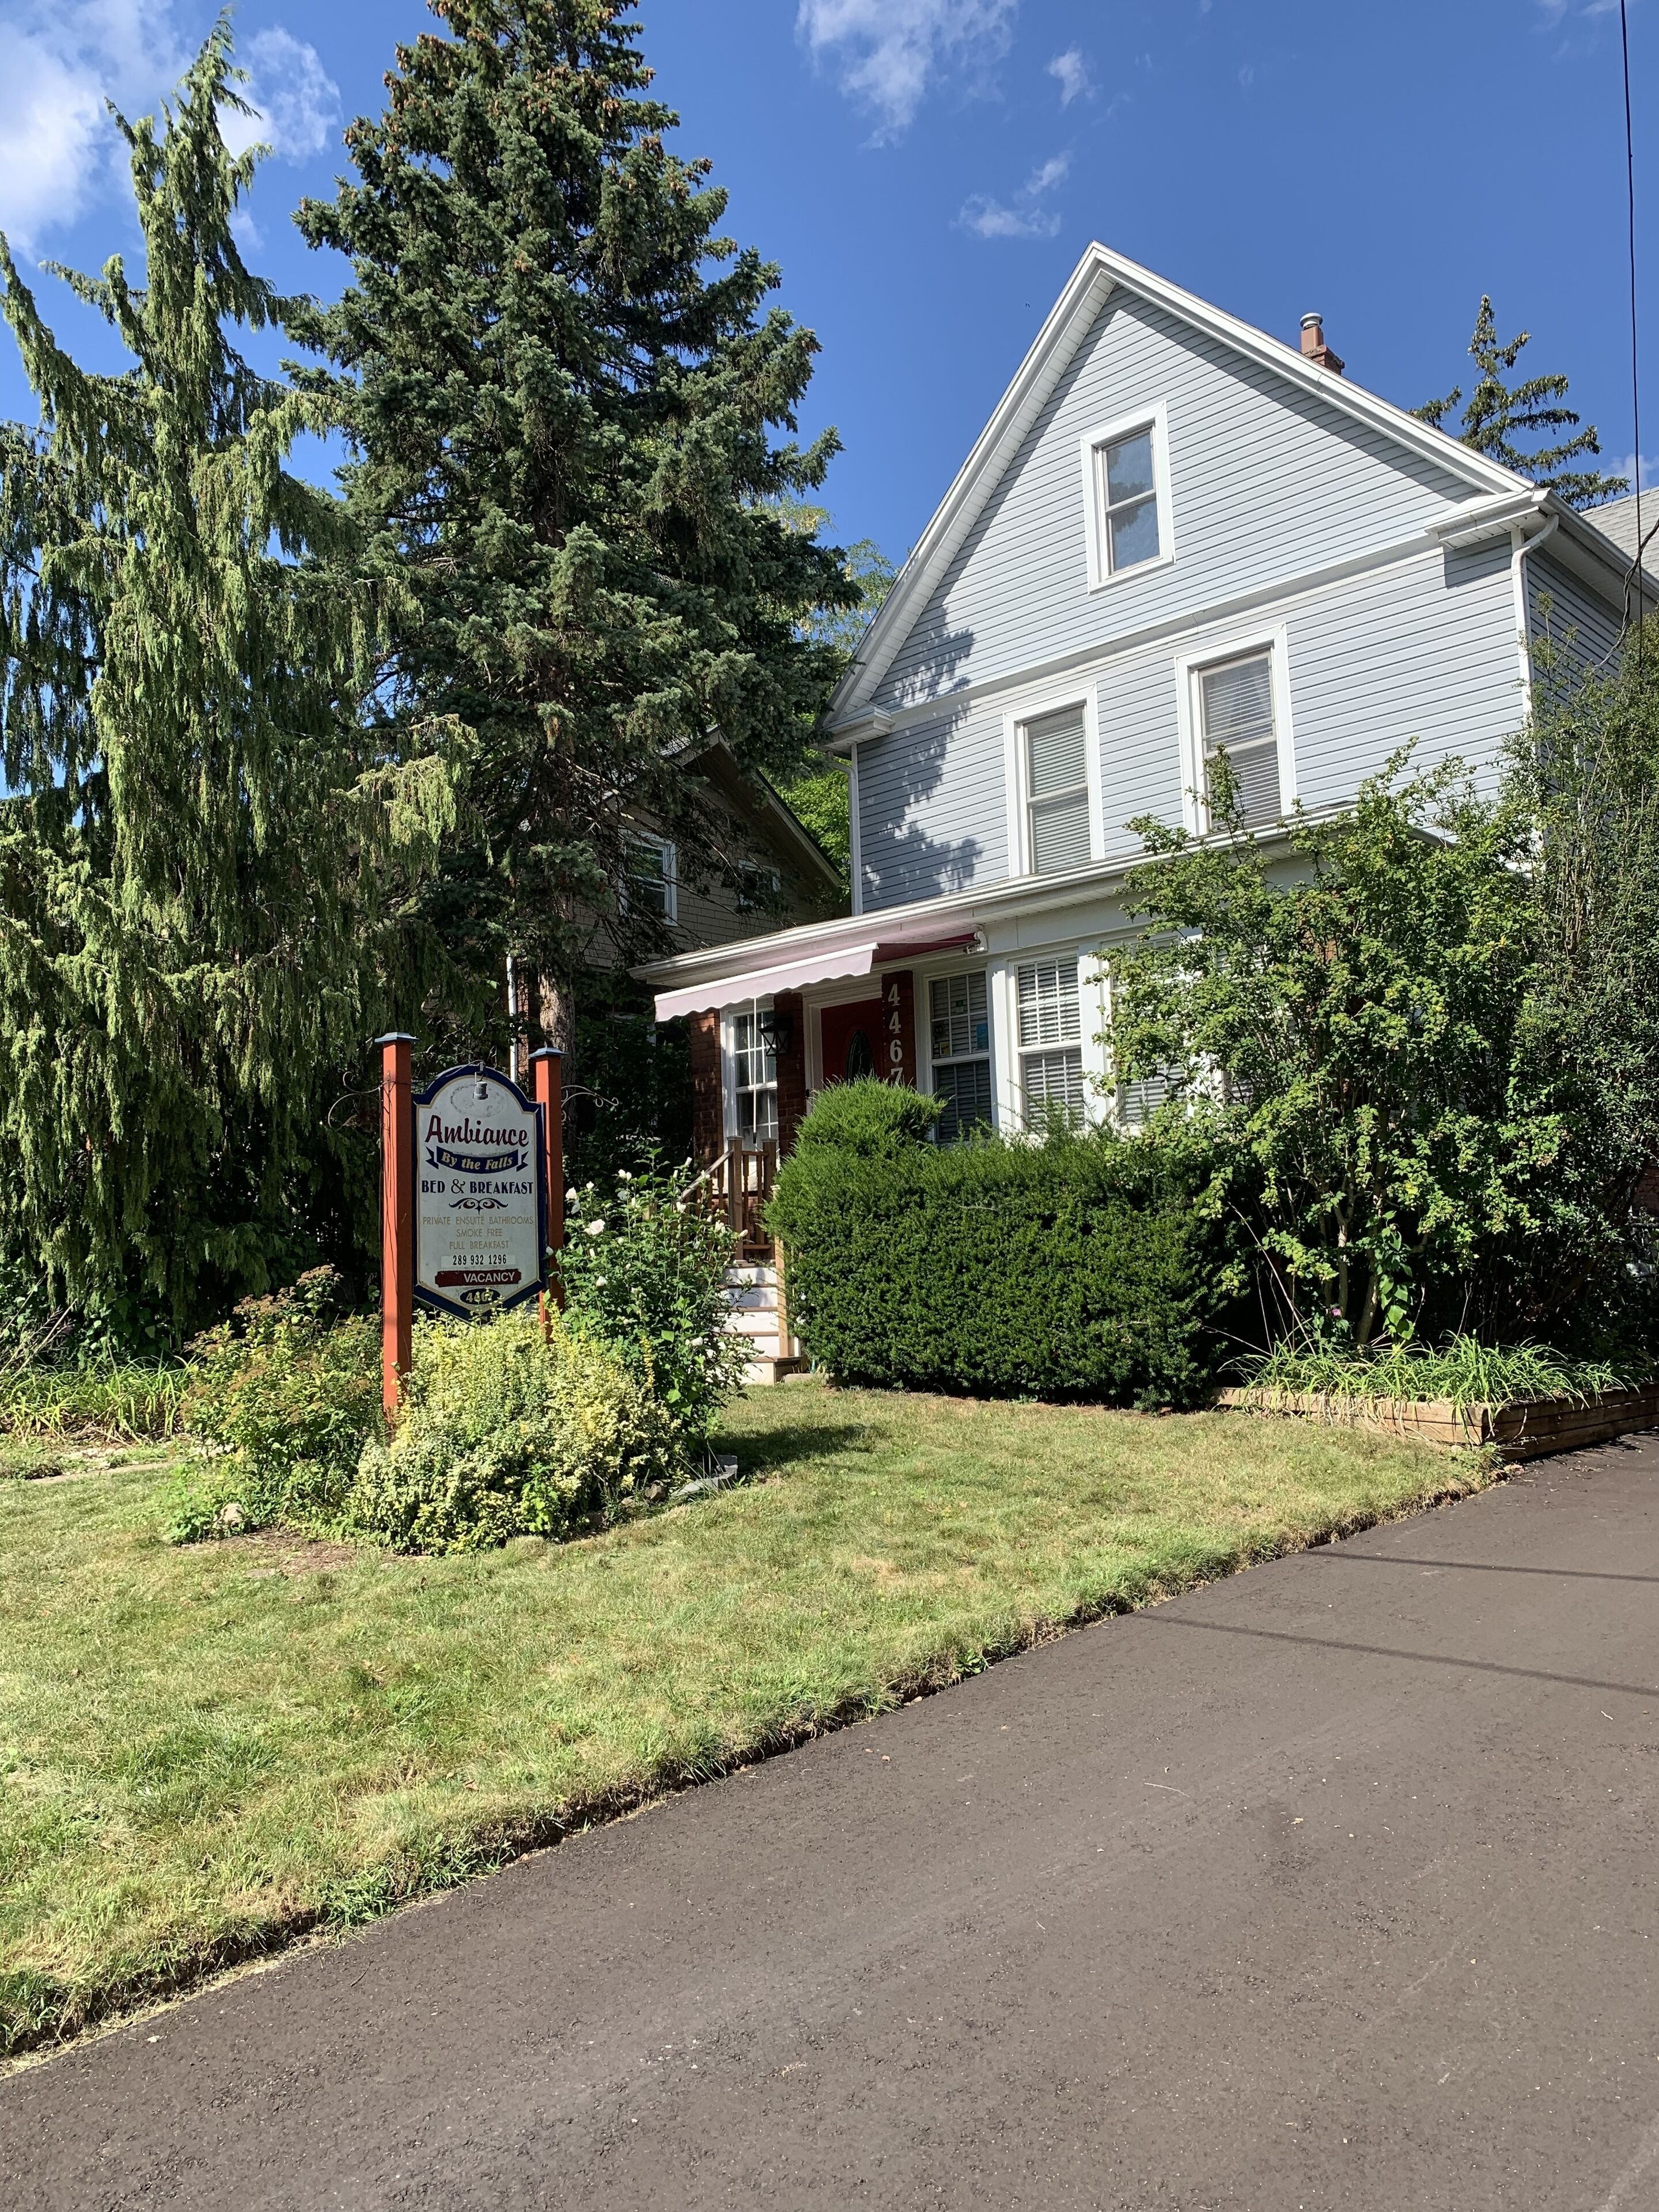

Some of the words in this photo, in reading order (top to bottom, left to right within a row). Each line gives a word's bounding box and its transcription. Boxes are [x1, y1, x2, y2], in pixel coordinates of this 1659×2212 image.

[425, 1115, 529, 1147] Ambiance
[441, 1152, 457, 1166] By
[461, 1157, 480, 1169] the
[485, 1156, 513, 1170] Falls
[422, 1180, 445, 1193] BED
[451, 1179, 465, 1194] &
[469, 1181, 534, 1194] BREAKFAST
[423, 1217, 451, 1225] PRIVATE
[456, 1216, 484, 1225] ENSUITE
[489, 1216, 534, 1225] BATHROOMS
[456, 1229, 483, 1237] SMOKE
[487, 1228, 503, 1237] FREE
[449, 1241, 465, 1249] FULL
[469, 1240, 509, 1249] BREAKFAST
[453, 1255, 467, 1265] 289
[470, 1255, 484, 1265] 932
[488, 1255, 506, 1264] 1296
[463, 1272, 516, 1283] VACANCY
